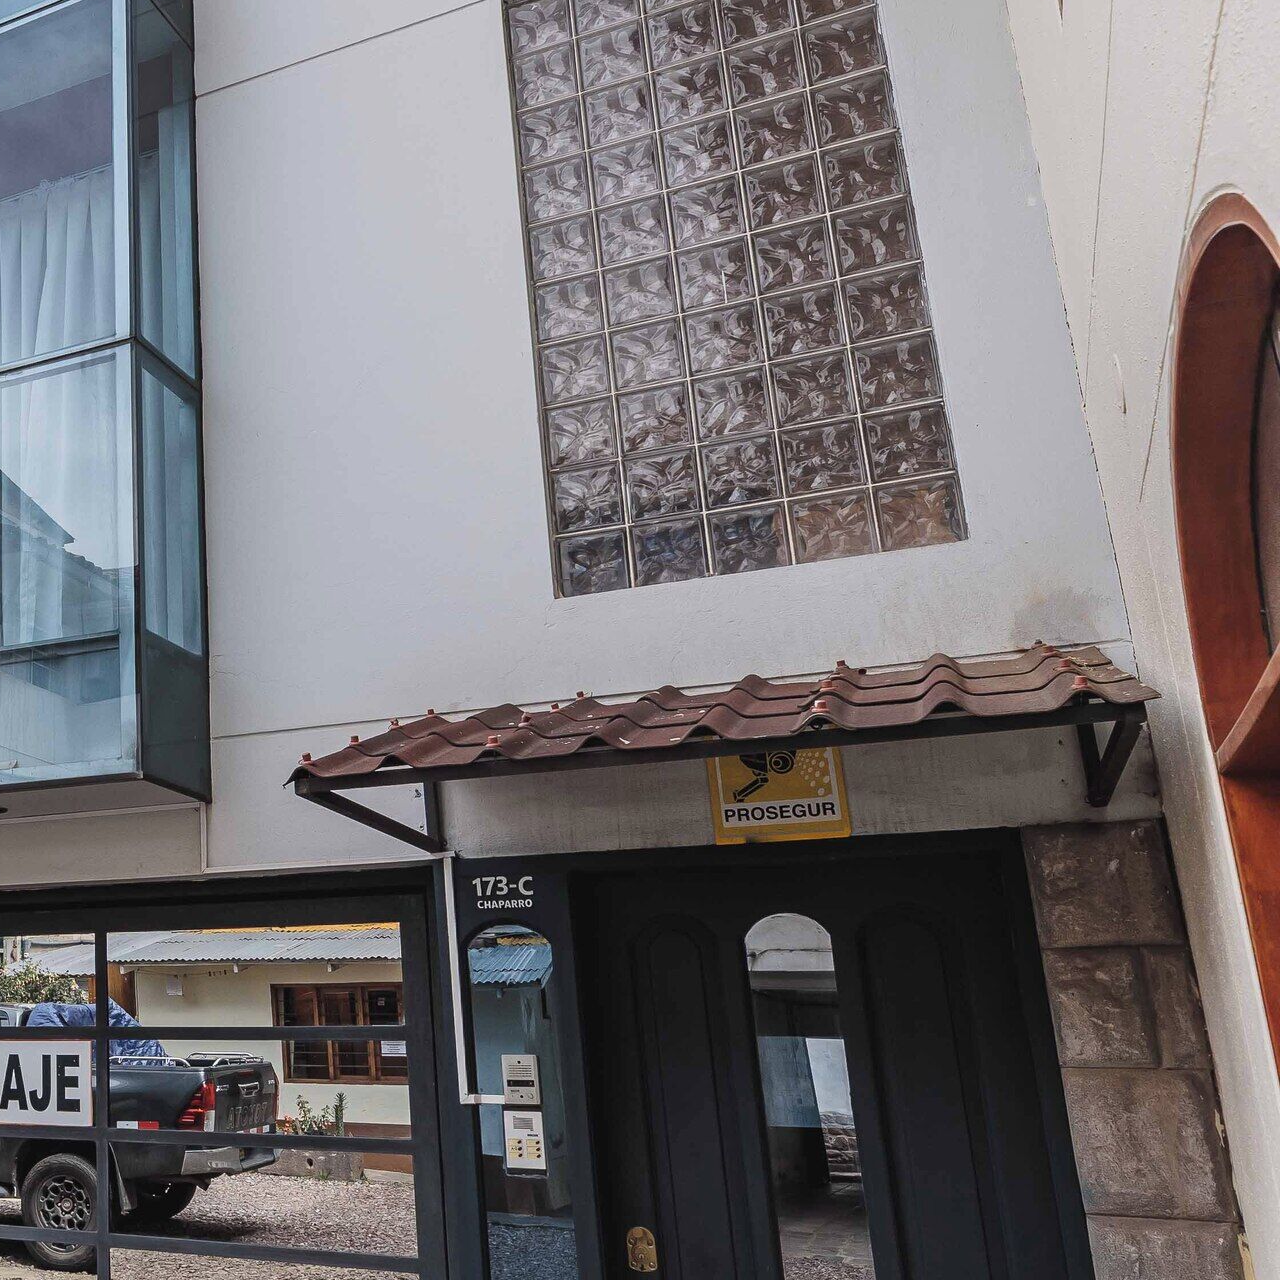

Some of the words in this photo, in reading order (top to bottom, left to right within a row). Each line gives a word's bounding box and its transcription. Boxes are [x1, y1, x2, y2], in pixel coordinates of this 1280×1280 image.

[724, 801, 836, 823] PROSEGUR
[472, 875, 534, 896] 173-C
[477, 898, 533, 909] CHAPARRO
